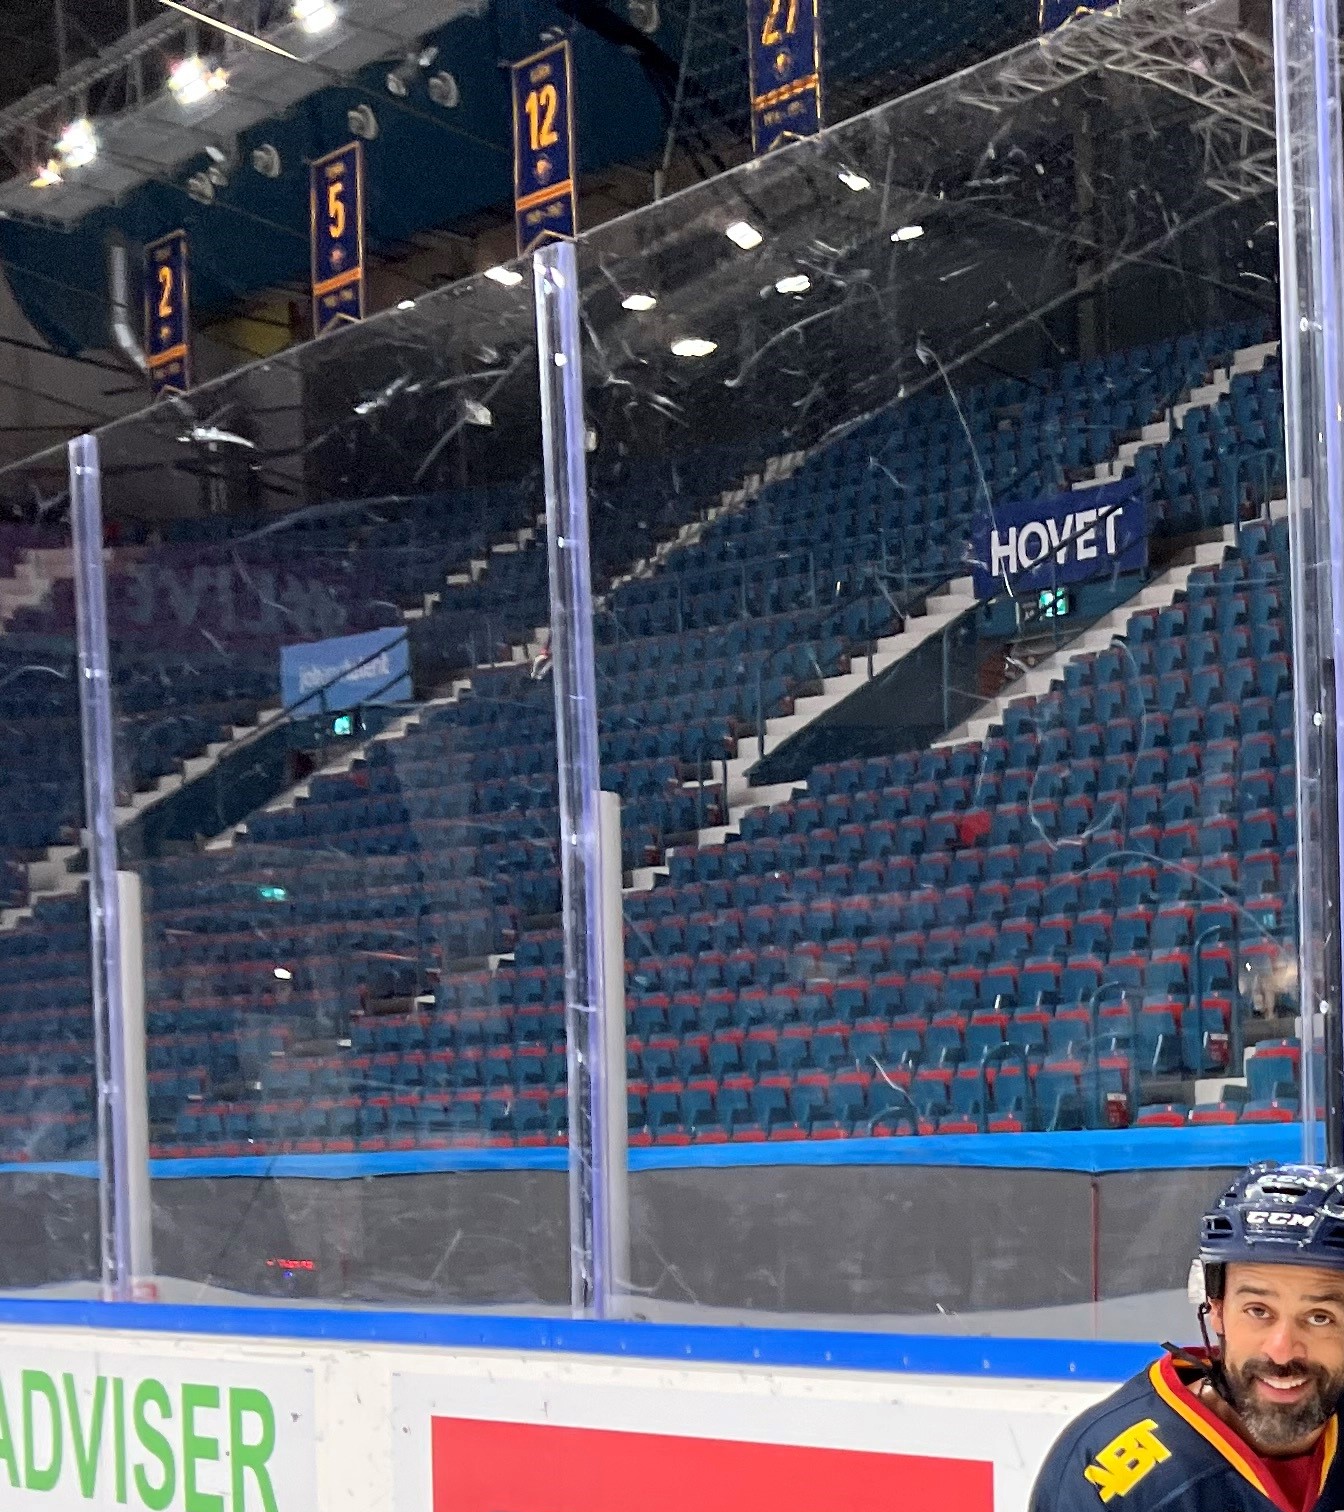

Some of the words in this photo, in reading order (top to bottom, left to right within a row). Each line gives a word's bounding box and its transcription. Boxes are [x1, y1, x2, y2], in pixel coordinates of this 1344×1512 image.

[526, 83, 559, 150] 12
[328, 182, 346, 239] 5
[158, 266, 173, 318] 2
[991, 504, 1124, 577] HOVET
[1246, 1211, 1316, 1227] CCM
